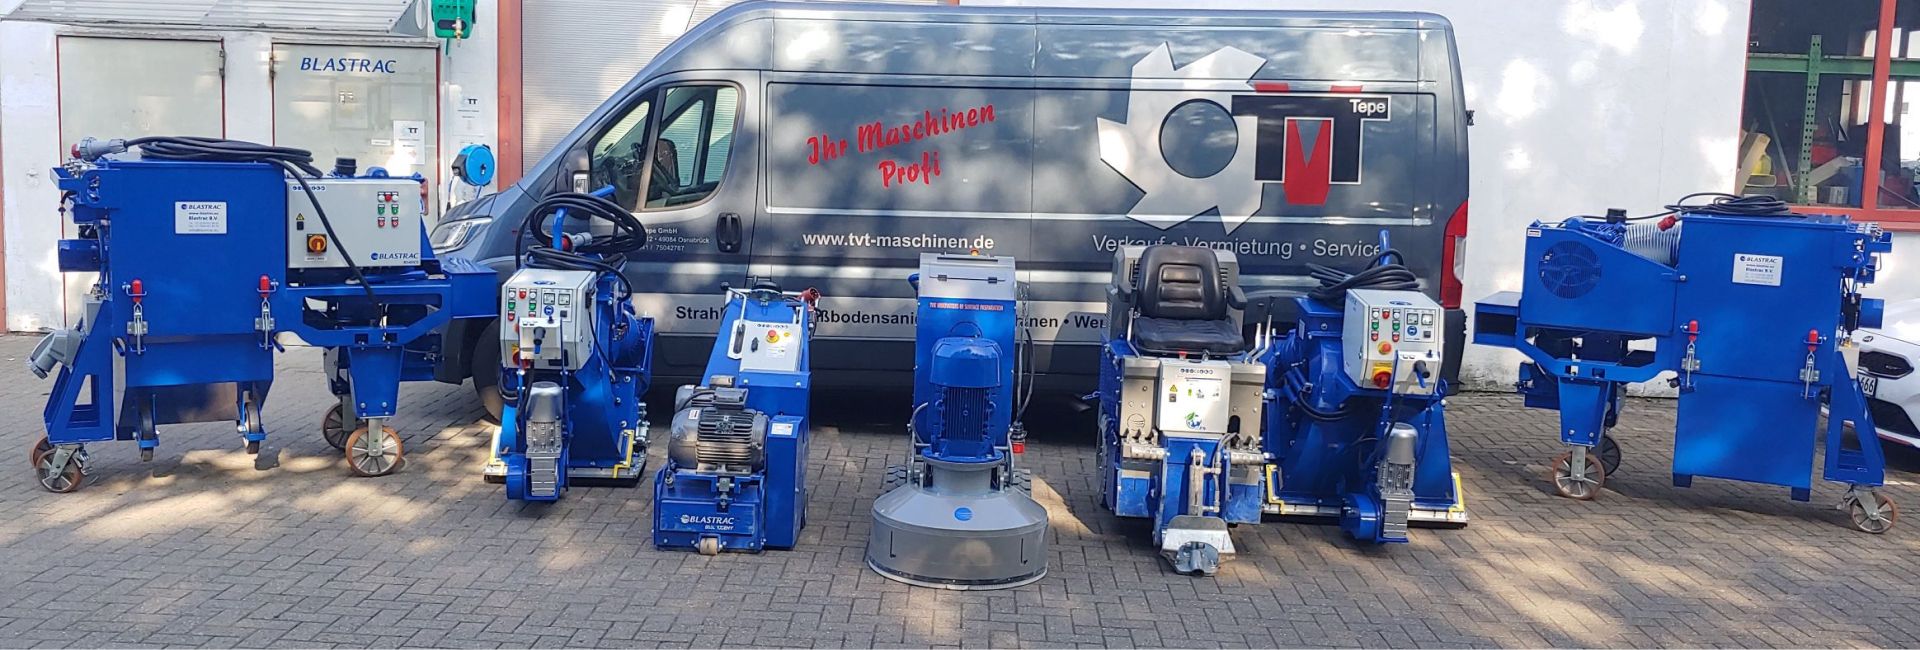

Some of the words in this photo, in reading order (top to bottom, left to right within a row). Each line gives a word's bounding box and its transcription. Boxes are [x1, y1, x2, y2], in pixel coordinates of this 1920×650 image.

[300, 57, 397, 74] BLASTRAC
[1349, 98, 1386, 117] Tepe
[807, 134, 848, 166] Ihr
[857, 104, 996, 153] Maschinen
[878, 151, 942, 188] Profi
[802, 232, 994, 249] www.tvt-maschinen.de
[378, 252, 419, 260] BLASTRAC
[689, 515, 735, 525] BLASTRAC
